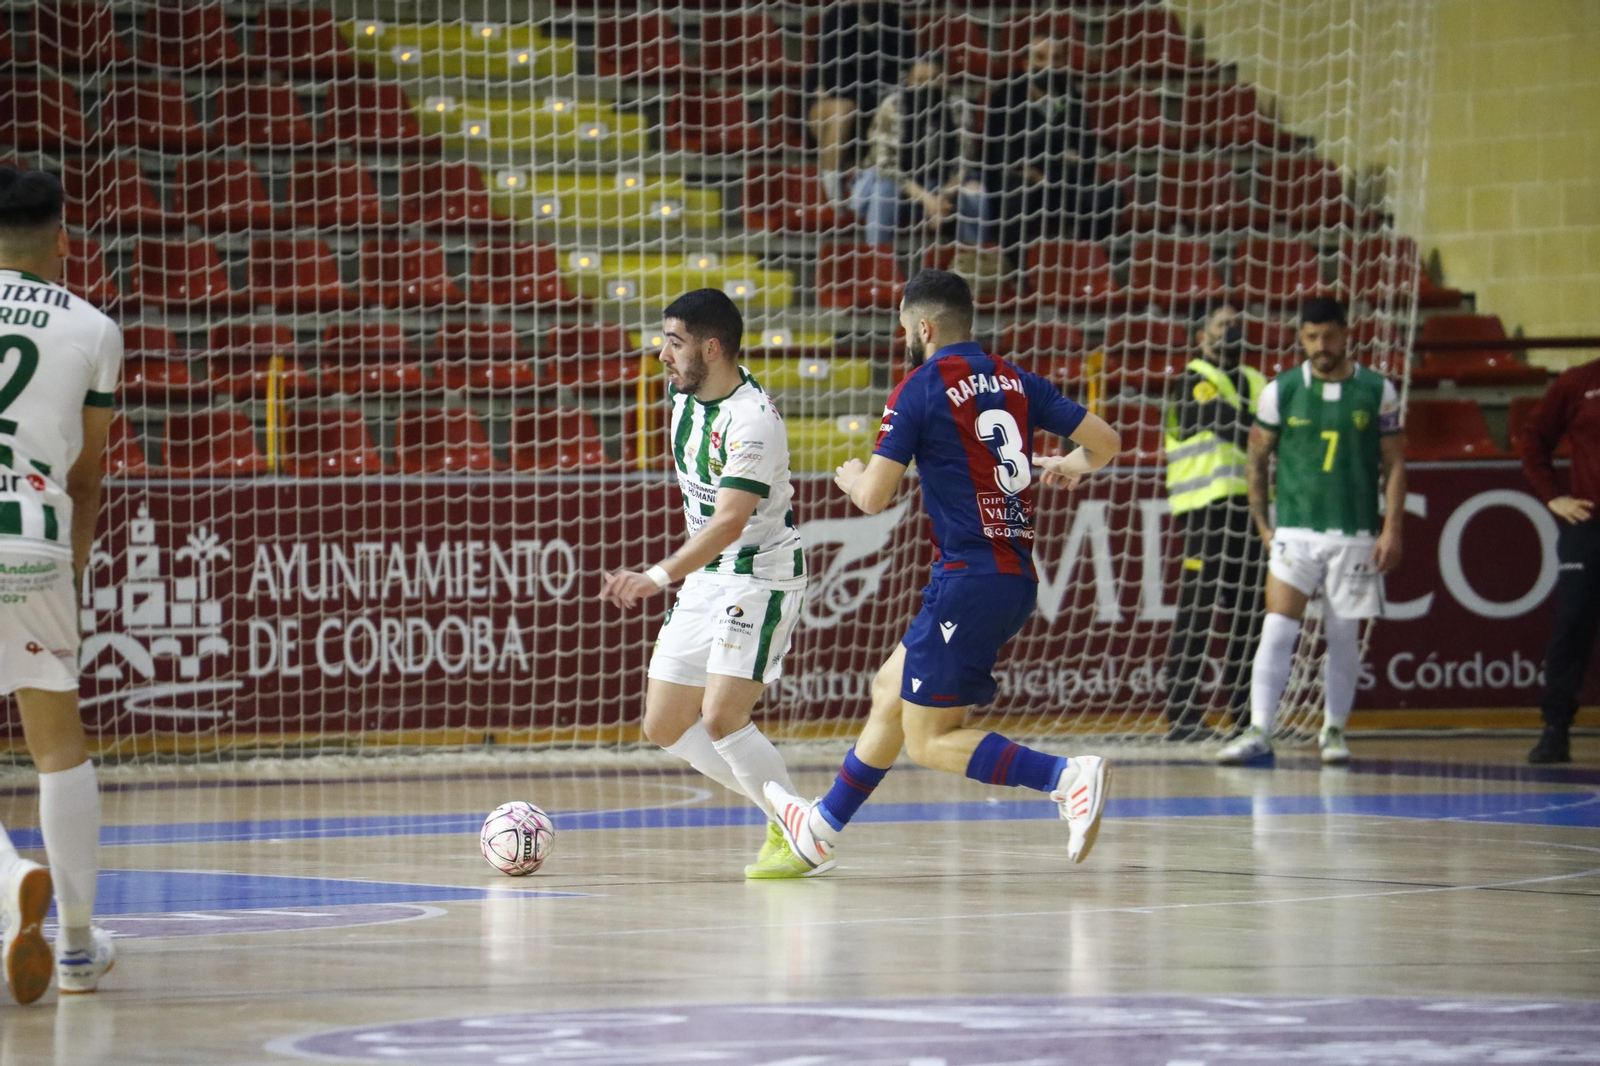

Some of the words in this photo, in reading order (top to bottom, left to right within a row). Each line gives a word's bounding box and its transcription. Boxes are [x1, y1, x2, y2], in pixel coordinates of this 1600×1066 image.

[3, 284, 71, 310] TEXTIL
[974, 408, 1032, 496] 3
[1320, 430, 1340, 472] 7
[246, 538, 576, 600] AYUNTAMIENTO
[248, 618, 301, 677] DE
[990, 658, 1116, 705] nicipal
[1387, 651, 1547, 690] Córdob
